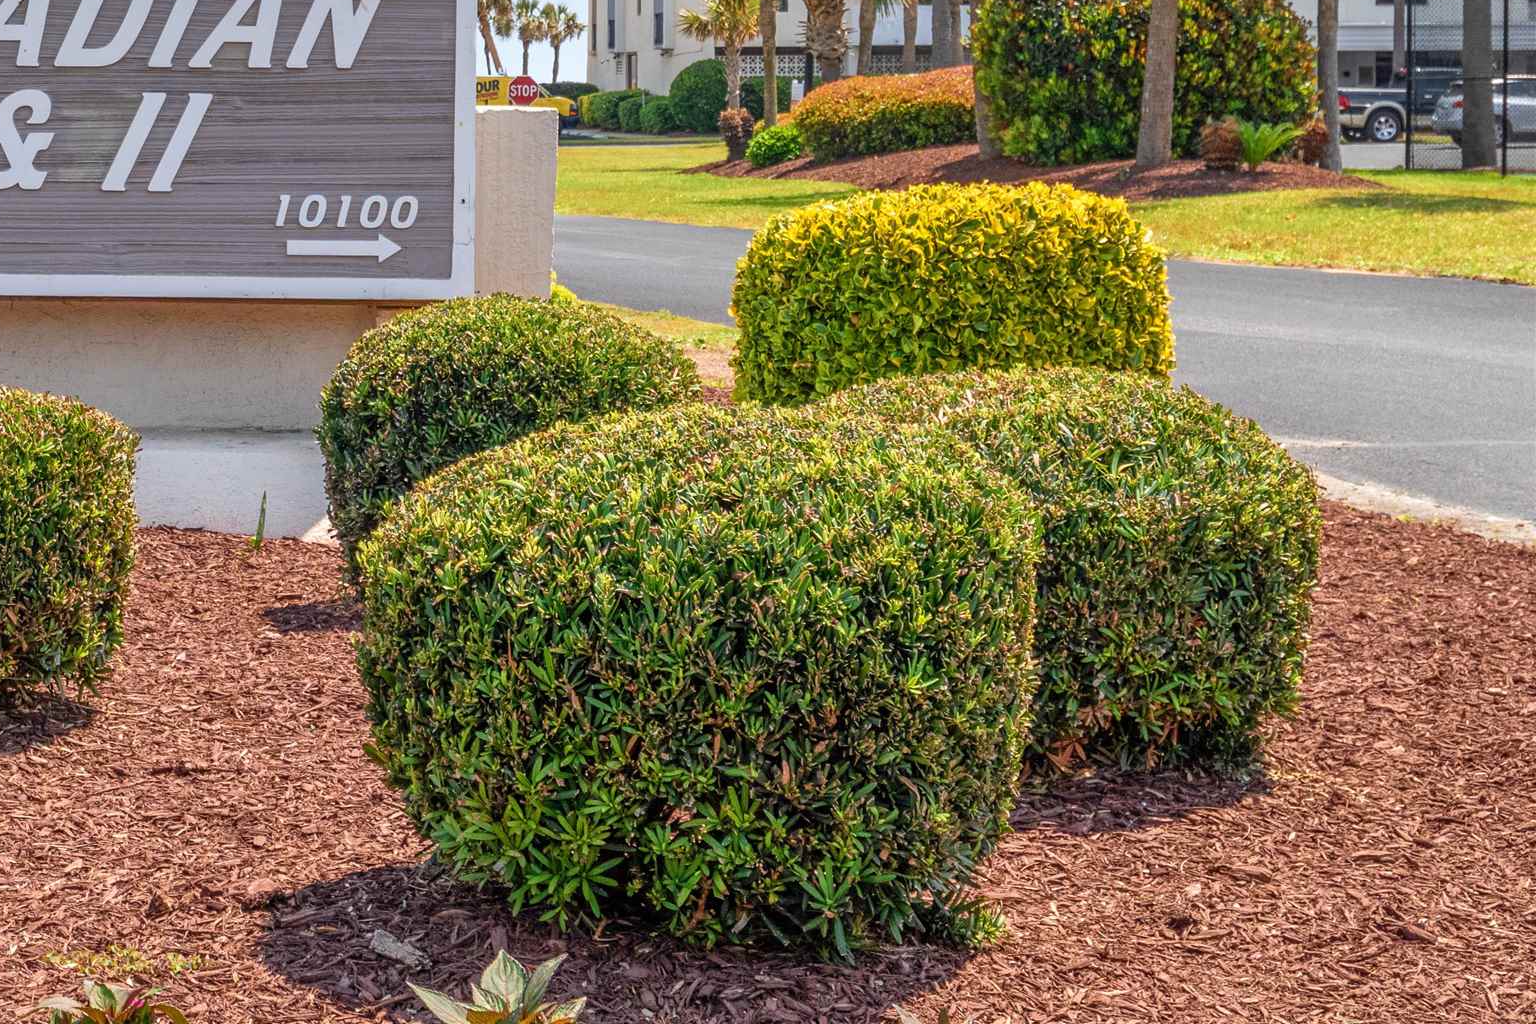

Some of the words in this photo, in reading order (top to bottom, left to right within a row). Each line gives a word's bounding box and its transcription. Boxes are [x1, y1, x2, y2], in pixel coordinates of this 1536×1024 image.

[510, 84, 537, 97] STOP
[101, 92, 213, 192] II
[275, 194, 419, 229] 10100
